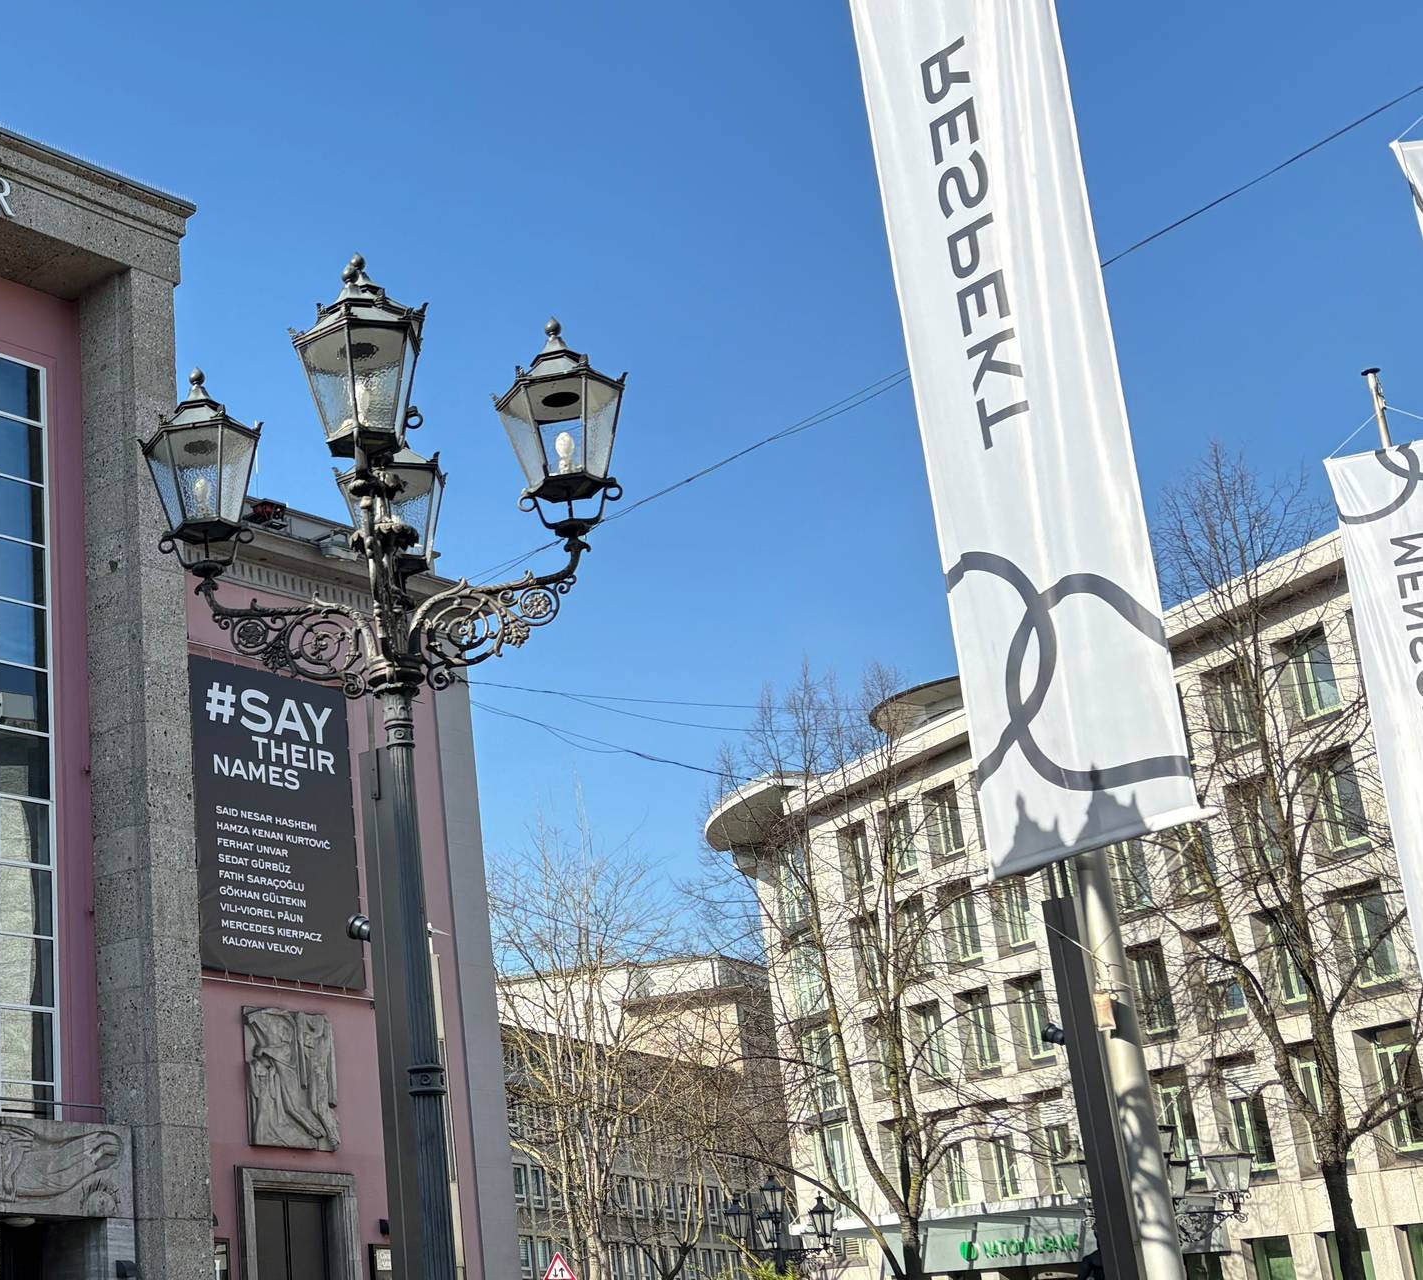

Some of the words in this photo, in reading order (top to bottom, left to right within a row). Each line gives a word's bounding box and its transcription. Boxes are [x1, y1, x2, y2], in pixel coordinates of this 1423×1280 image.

[205, 682, 332, 745] #SAY
[251, 735, 335, 774] THEIR
[212, 754, 300, 790] NAMES
[215, 805, 238, 817] SAID
[240, 810, 273, 823] NESAR
[275, 817, 317, 832] HASHEMI
[216, 821, 250, 835] HAMZA
[251, 828, 283, 841] KENAN
[217, 837, 254, 851] FERHAT
[256, 844, 289, 858] UNVAR
[218, 853, 249, 866] SEDAT
[251, 858, 291, 874] GÜRBÜZ
[218, 869, 244, 882] FATIH
[219, 885, 260, 900] GÖKHAN
[262, 893, 307, 908] GÜLTEKIN
[220, 902, 275, 919] VILI-VIOREL
[221, 919, 275, 935] MERCEDES
[277, 927, 322, 942] KIERPACZ
[222, 935, 265, 950] KALOYAN
[266, 942, 304, 956] VELKOV
